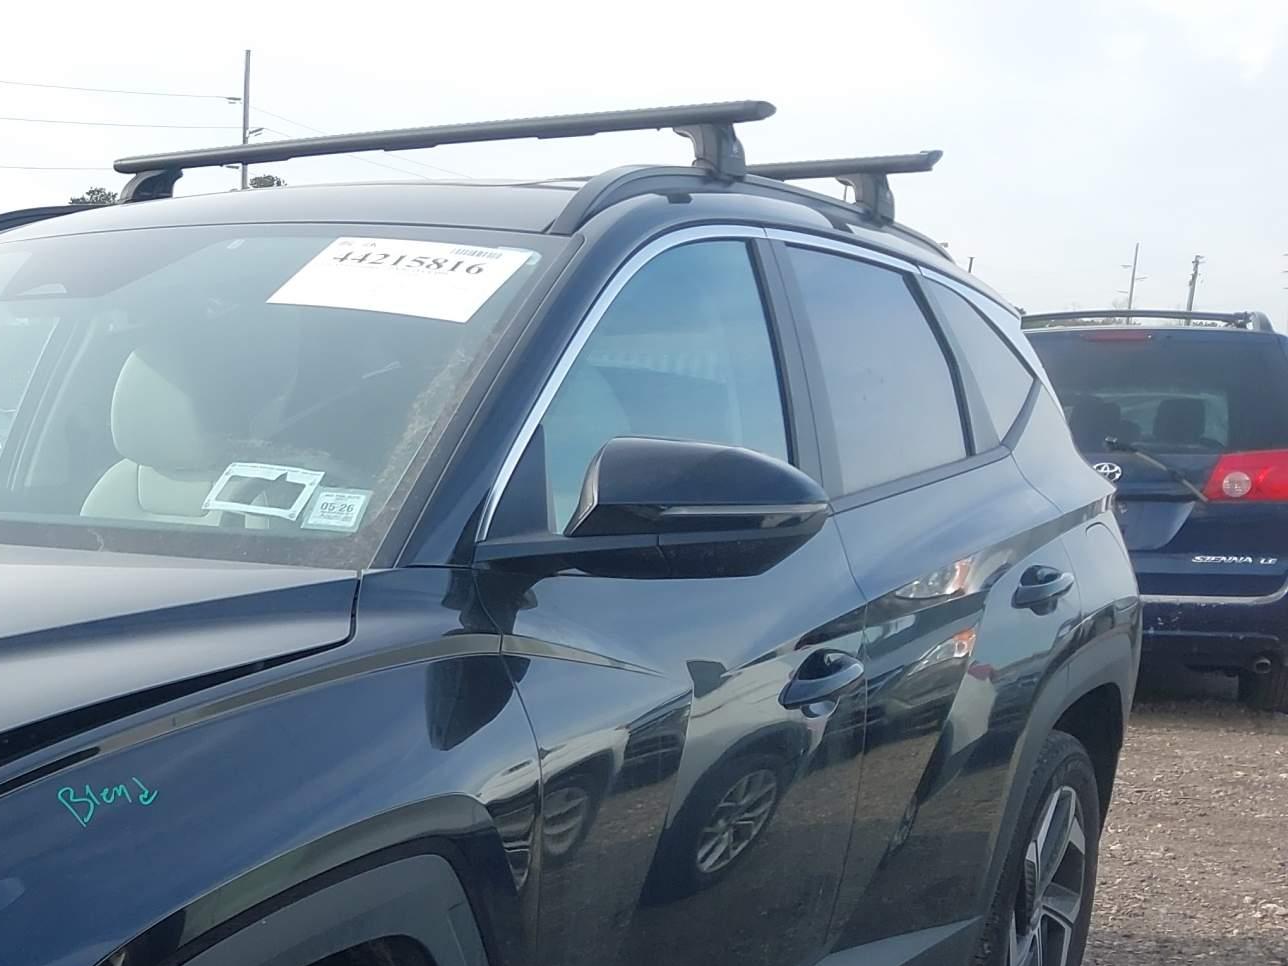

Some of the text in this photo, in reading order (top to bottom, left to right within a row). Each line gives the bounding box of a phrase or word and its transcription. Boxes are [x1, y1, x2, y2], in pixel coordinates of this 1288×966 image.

[332, 251, 488, 275] 44215816
[1191, 555, 1278, 565] SIENNA LE
[57, 776, 159, 828] Blend
